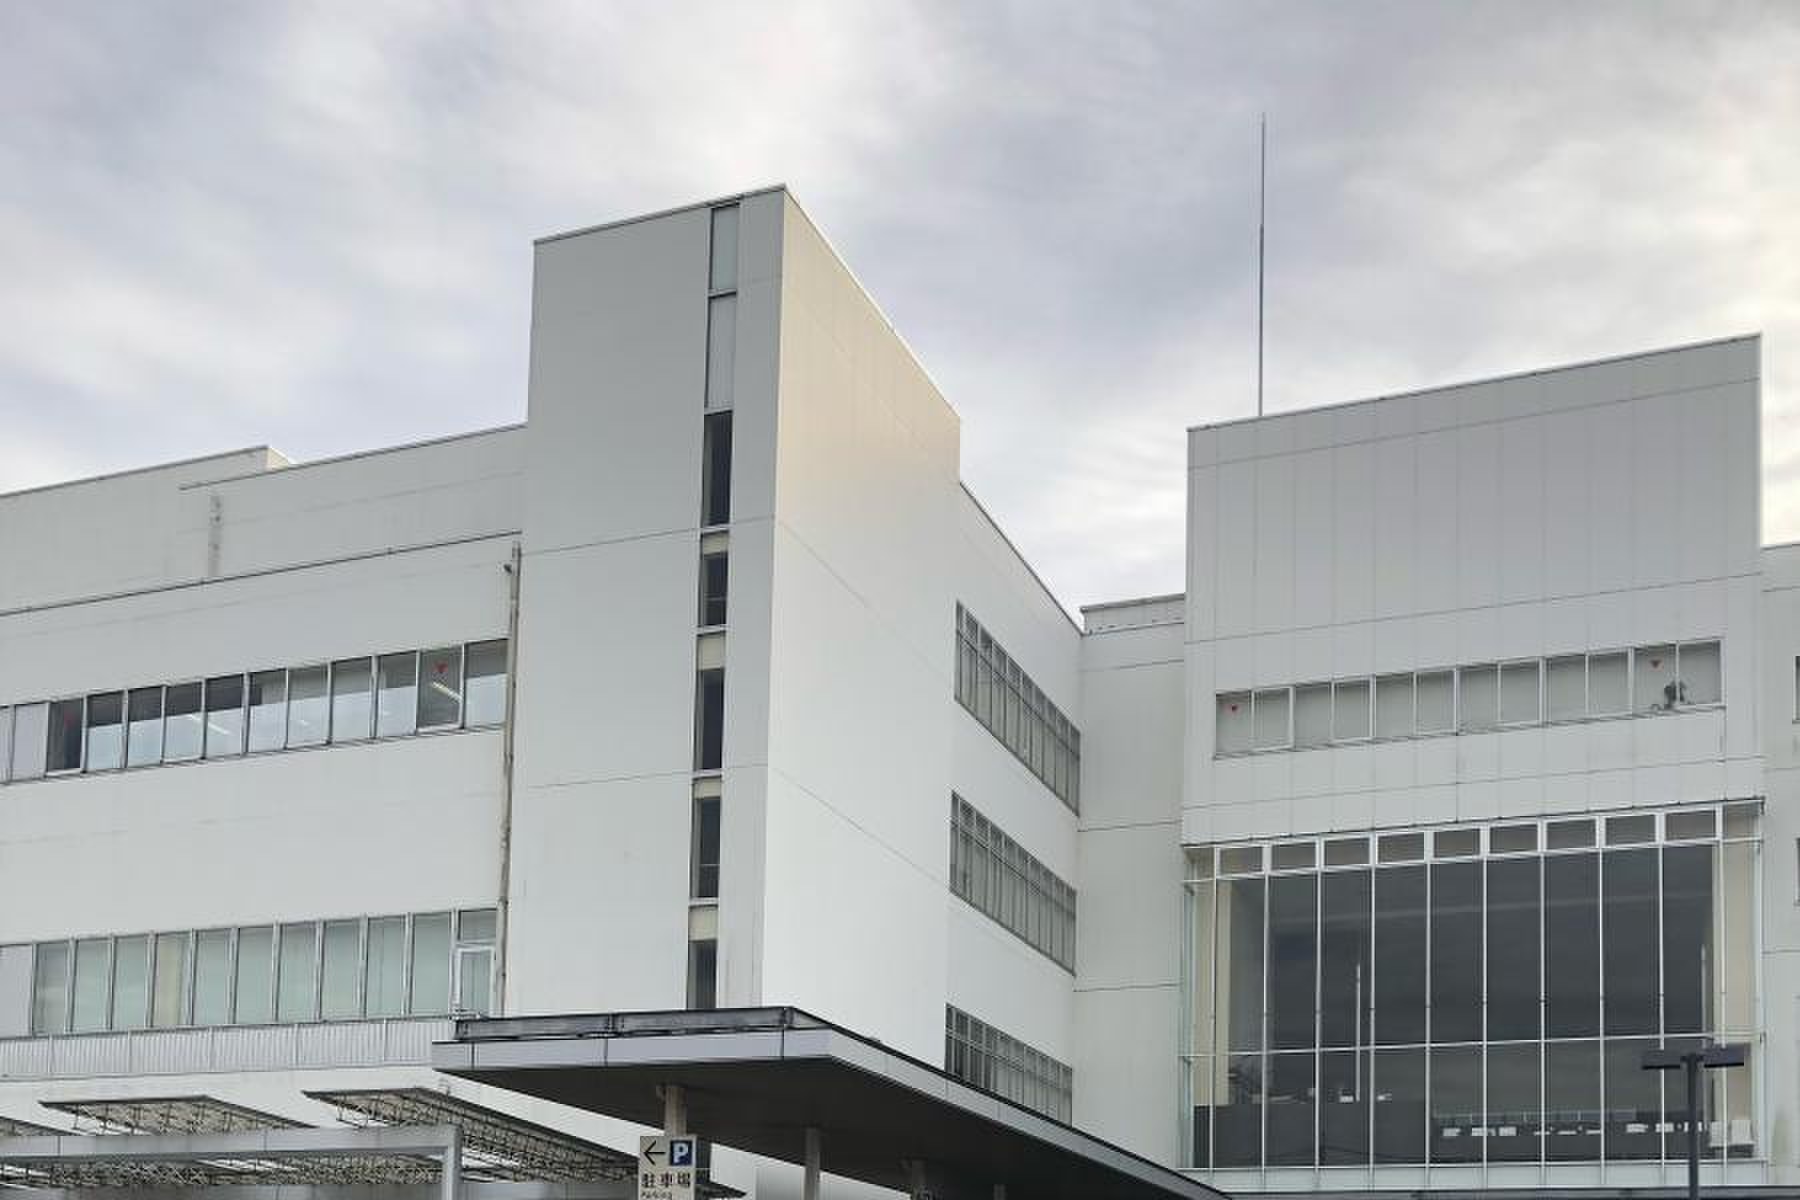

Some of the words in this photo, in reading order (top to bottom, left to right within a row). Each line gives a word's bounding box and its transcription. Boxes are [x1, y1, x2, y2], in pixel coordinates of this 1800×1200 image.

[673, 1142, 689, 1164] P
[641, 1172, 690, 1189] 駐車場
